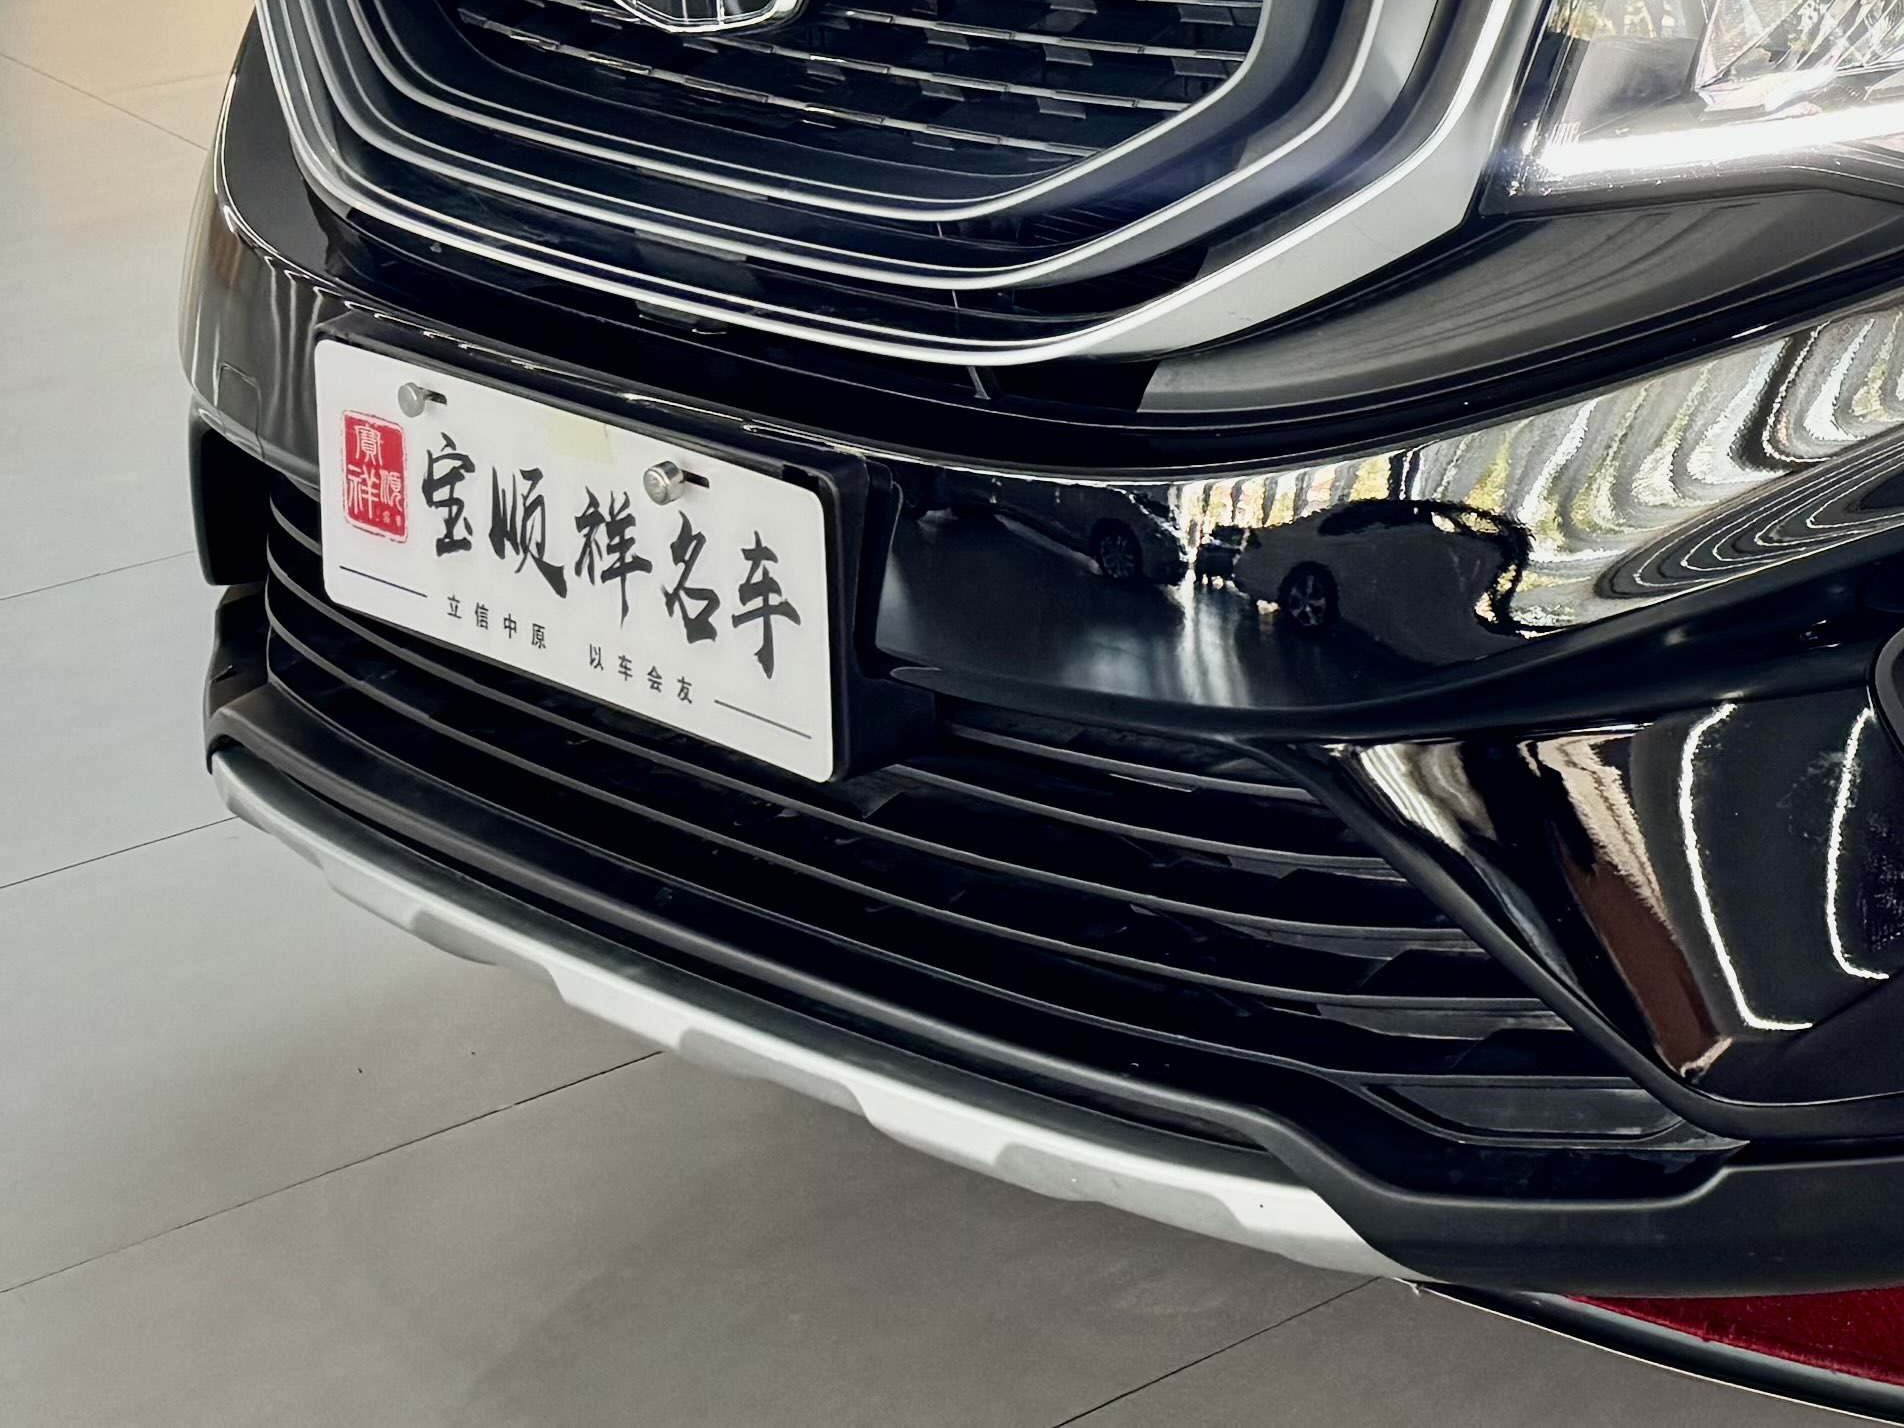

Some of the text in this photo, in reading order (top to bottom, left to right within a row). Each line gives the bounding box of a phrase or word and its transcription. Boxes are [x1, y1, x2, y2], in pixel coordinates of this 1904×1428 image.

[422, 433, 801, 679] 宝顺祥名车
[447, 594, 694, 705] 立信中原 以车会友
